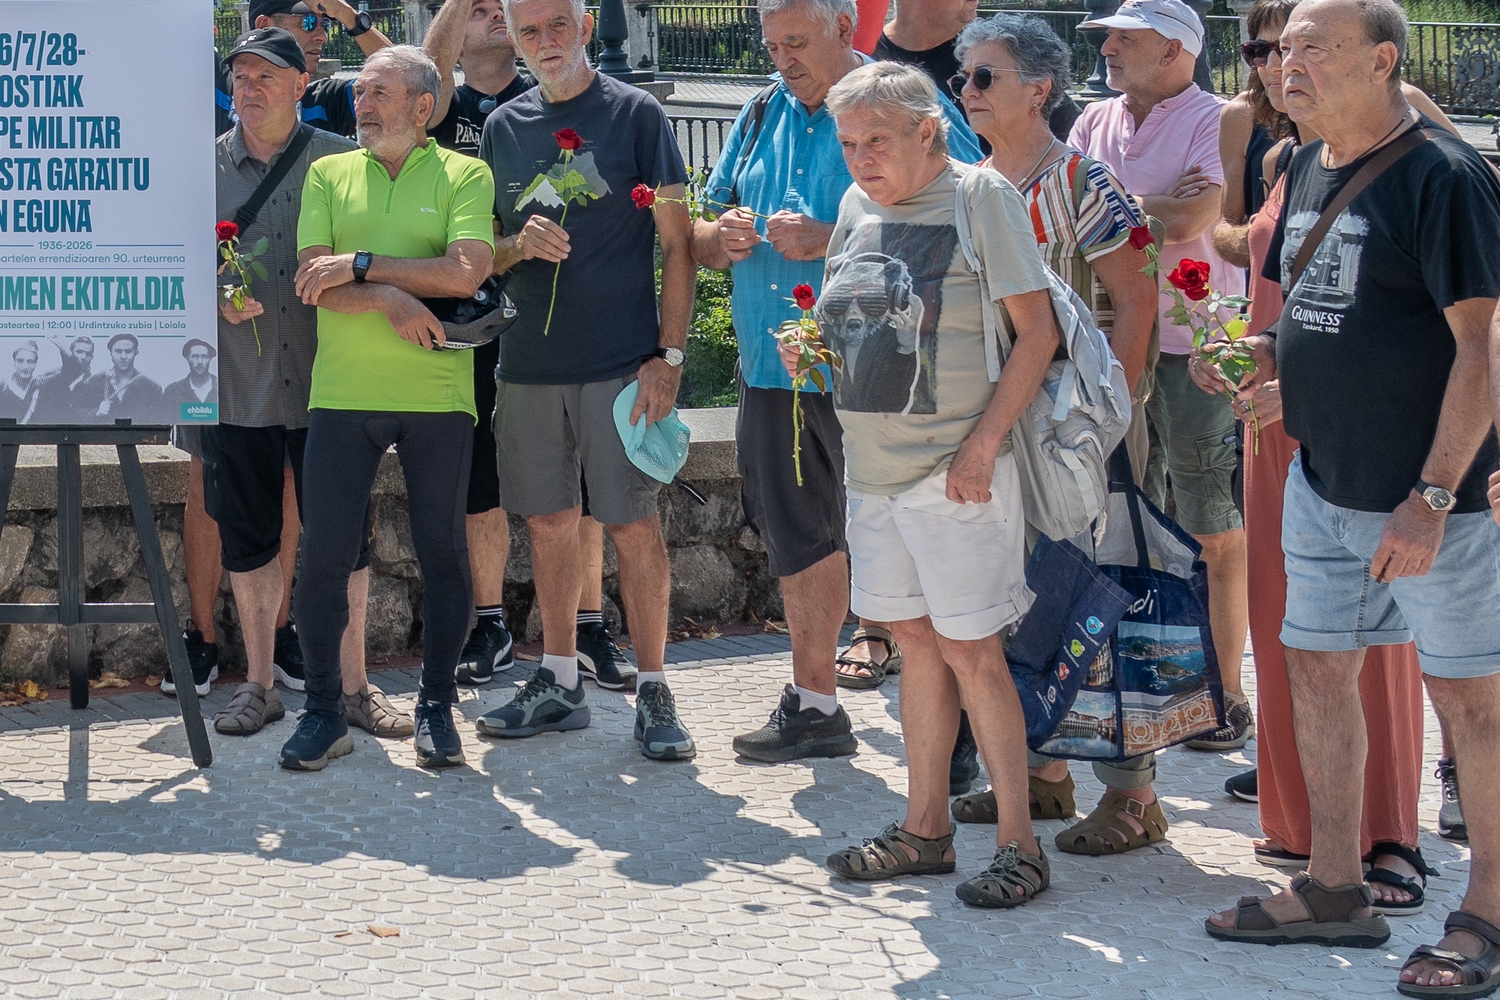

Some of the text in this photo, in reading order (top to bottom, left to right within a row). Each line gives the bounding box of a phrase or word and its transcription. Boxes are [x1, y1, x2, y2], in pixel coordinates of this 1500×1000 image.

[28, 116, 120, 149] MILITAR
[47, 157, 150, 191] GARAITU
[13, 199, 93, 233] EGUNA
[38, 240, 93, 250] 1936-2026
[39, 253, 111, 263] errendizioaren
[113, 253, 130, 263] 90.
[132, 254, 186, 263] urteurrena
[61, 275, 186, 311] EKITALDIA
[47, 321, 72, 329] 12:00
[78, 321, 127, 329] Urdintzuko
[128, 321, 152, 329] zubia
[159, 321, 186, 329] Loiola
[1291, 305, 1341, 326] GUINNESS
